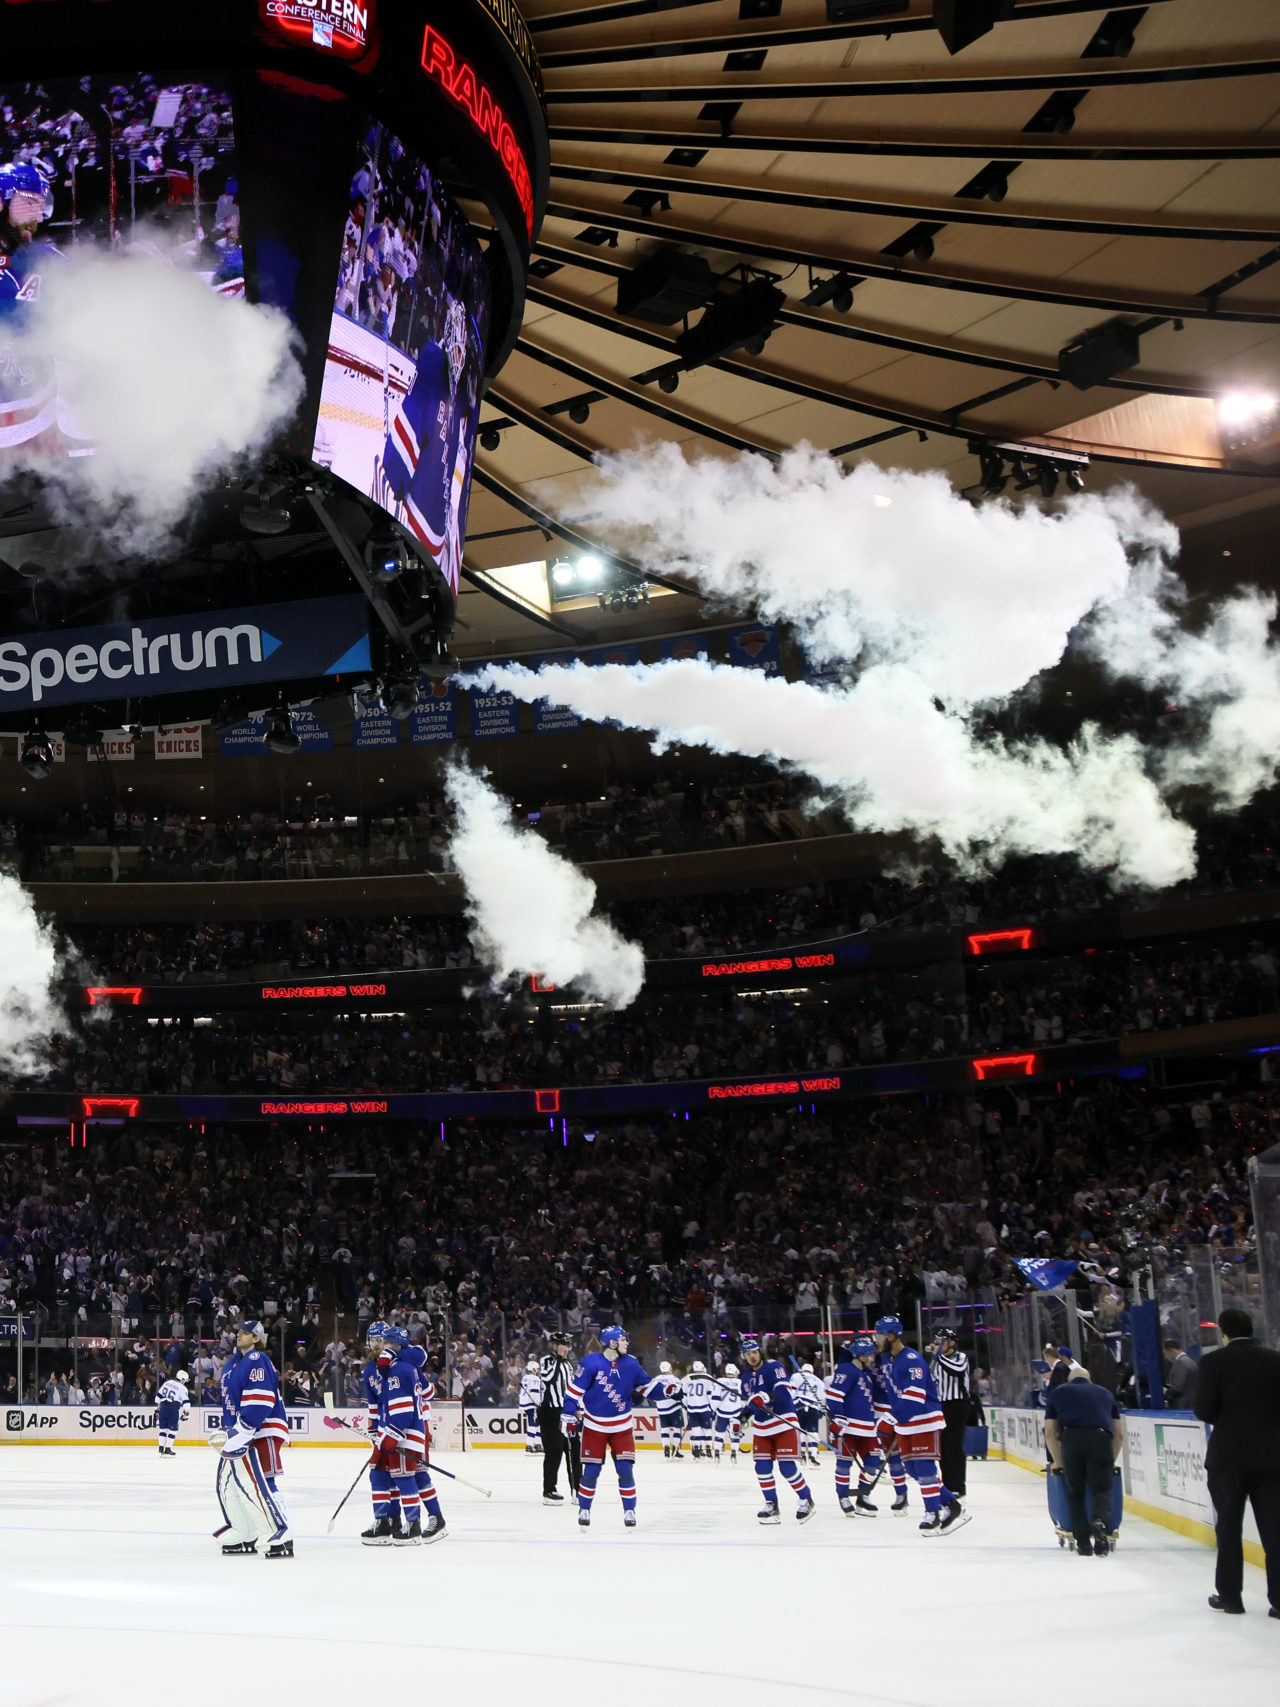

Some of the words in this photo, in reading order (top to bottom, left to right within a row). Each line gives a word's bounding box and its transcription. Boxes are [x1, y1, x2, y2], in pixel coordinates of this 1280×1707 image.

[266, 2, 340, 27] CONFERENCE
[342, 20, 366, 41] FINAL
[474, 696, 514, 709] 1952-53
[478, 710, 510, 718] EASTERN
[360, 719, 392, 728] EASTERN
[417, 716, 448, 724] EASTERN
[480, 718, 509, 727] DIVISION
[537, 720, 579, 730] CHAMPIONS
[232, 728, 256, 736] WORLD
[362, 728, 391, 737] DIVISION
[418, 724, 447, 732] DIVISION
[475, 727, 516, 736] CHAMPIONS
[224, 736, 264, 744] CHAMPIONS
[357, 737, 397, 745] CHAMPIONS
[413, 732, 453, 742] CHAMPIONS
[157, 740, 200, 754] KNICKS
[702, 958, 793, 976] RANGERS
[795, 954, 835, 968] WIN
[262, 986, 347, 999] RANGERS
[349, 984, 387, 996] WIN
[708, 1081, 799, 1099] RANGERS
[801, 1077, 841, 1092] WIN
[261, 1102, 348, 1114] RANGERS
[350, 1101, 388, 1113] WIN
[249, 1368, 265, 1382] 40
[834, 1374, 847, 1384] 77
[388, 1376, 401, 1391] 23
[595, 1370, 627, 1412] RANGERS
[688, 1383, 704, 1397] 20
[79, 1410, 159, 1433] Spectru
[488, 1413, 528, 1434] adi
